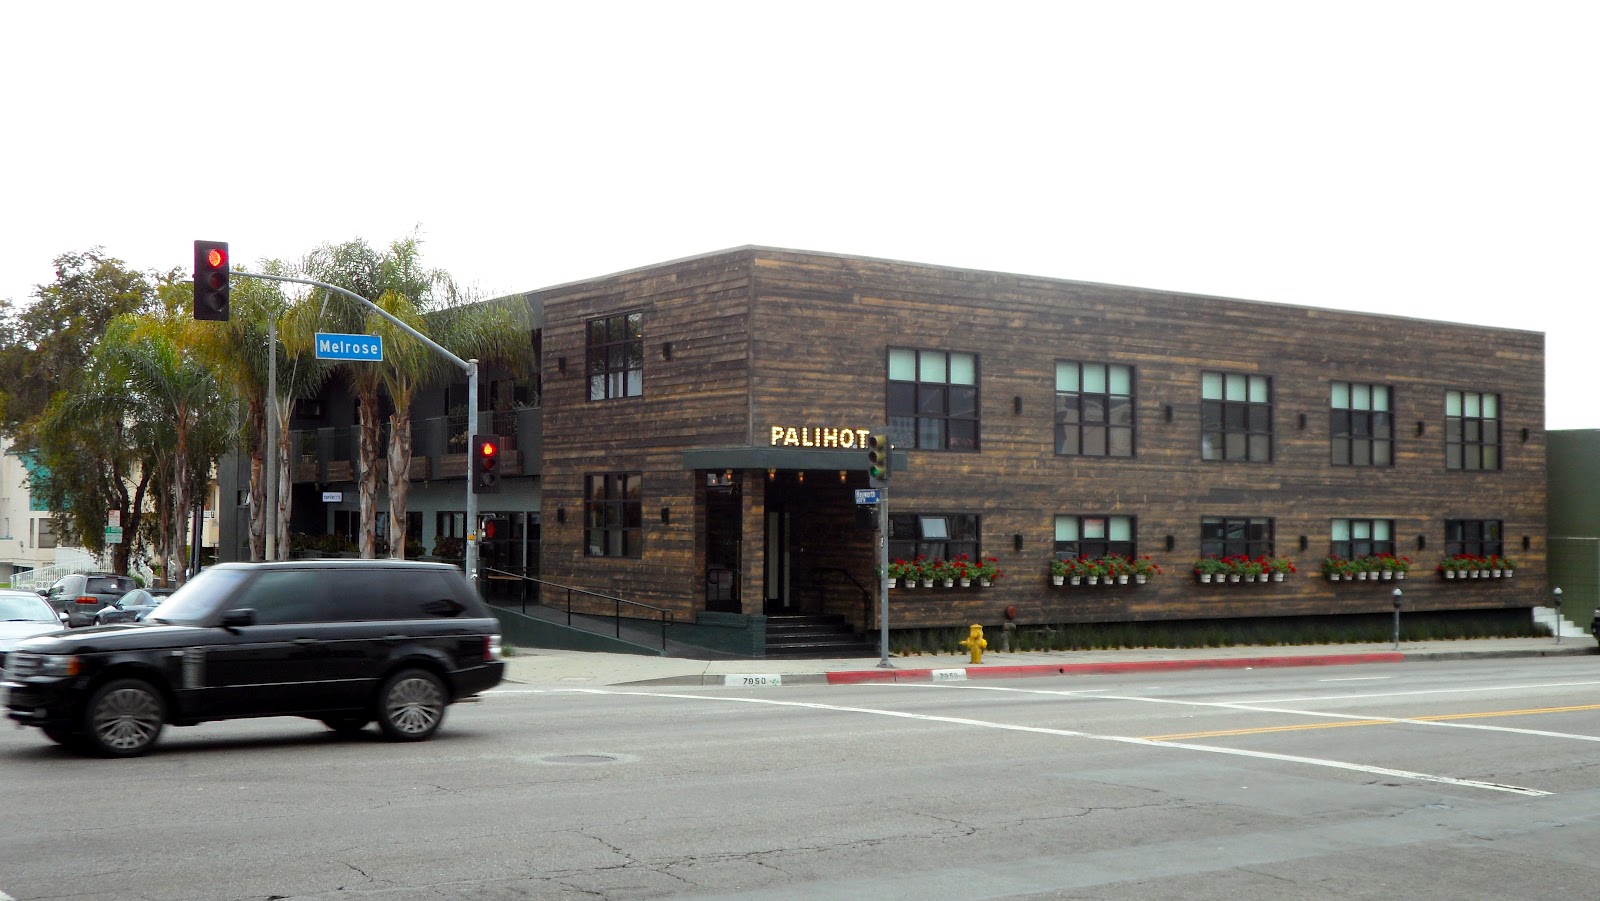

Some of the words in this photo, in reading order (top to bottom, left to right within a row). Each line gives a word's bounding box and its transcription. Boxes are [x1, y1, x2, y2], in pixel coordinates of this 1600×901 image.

[319, 339, 378, 355] Melrose
[771, 426, 888, 449] PALIHOT
[743, 677, 767, 686] 7950
